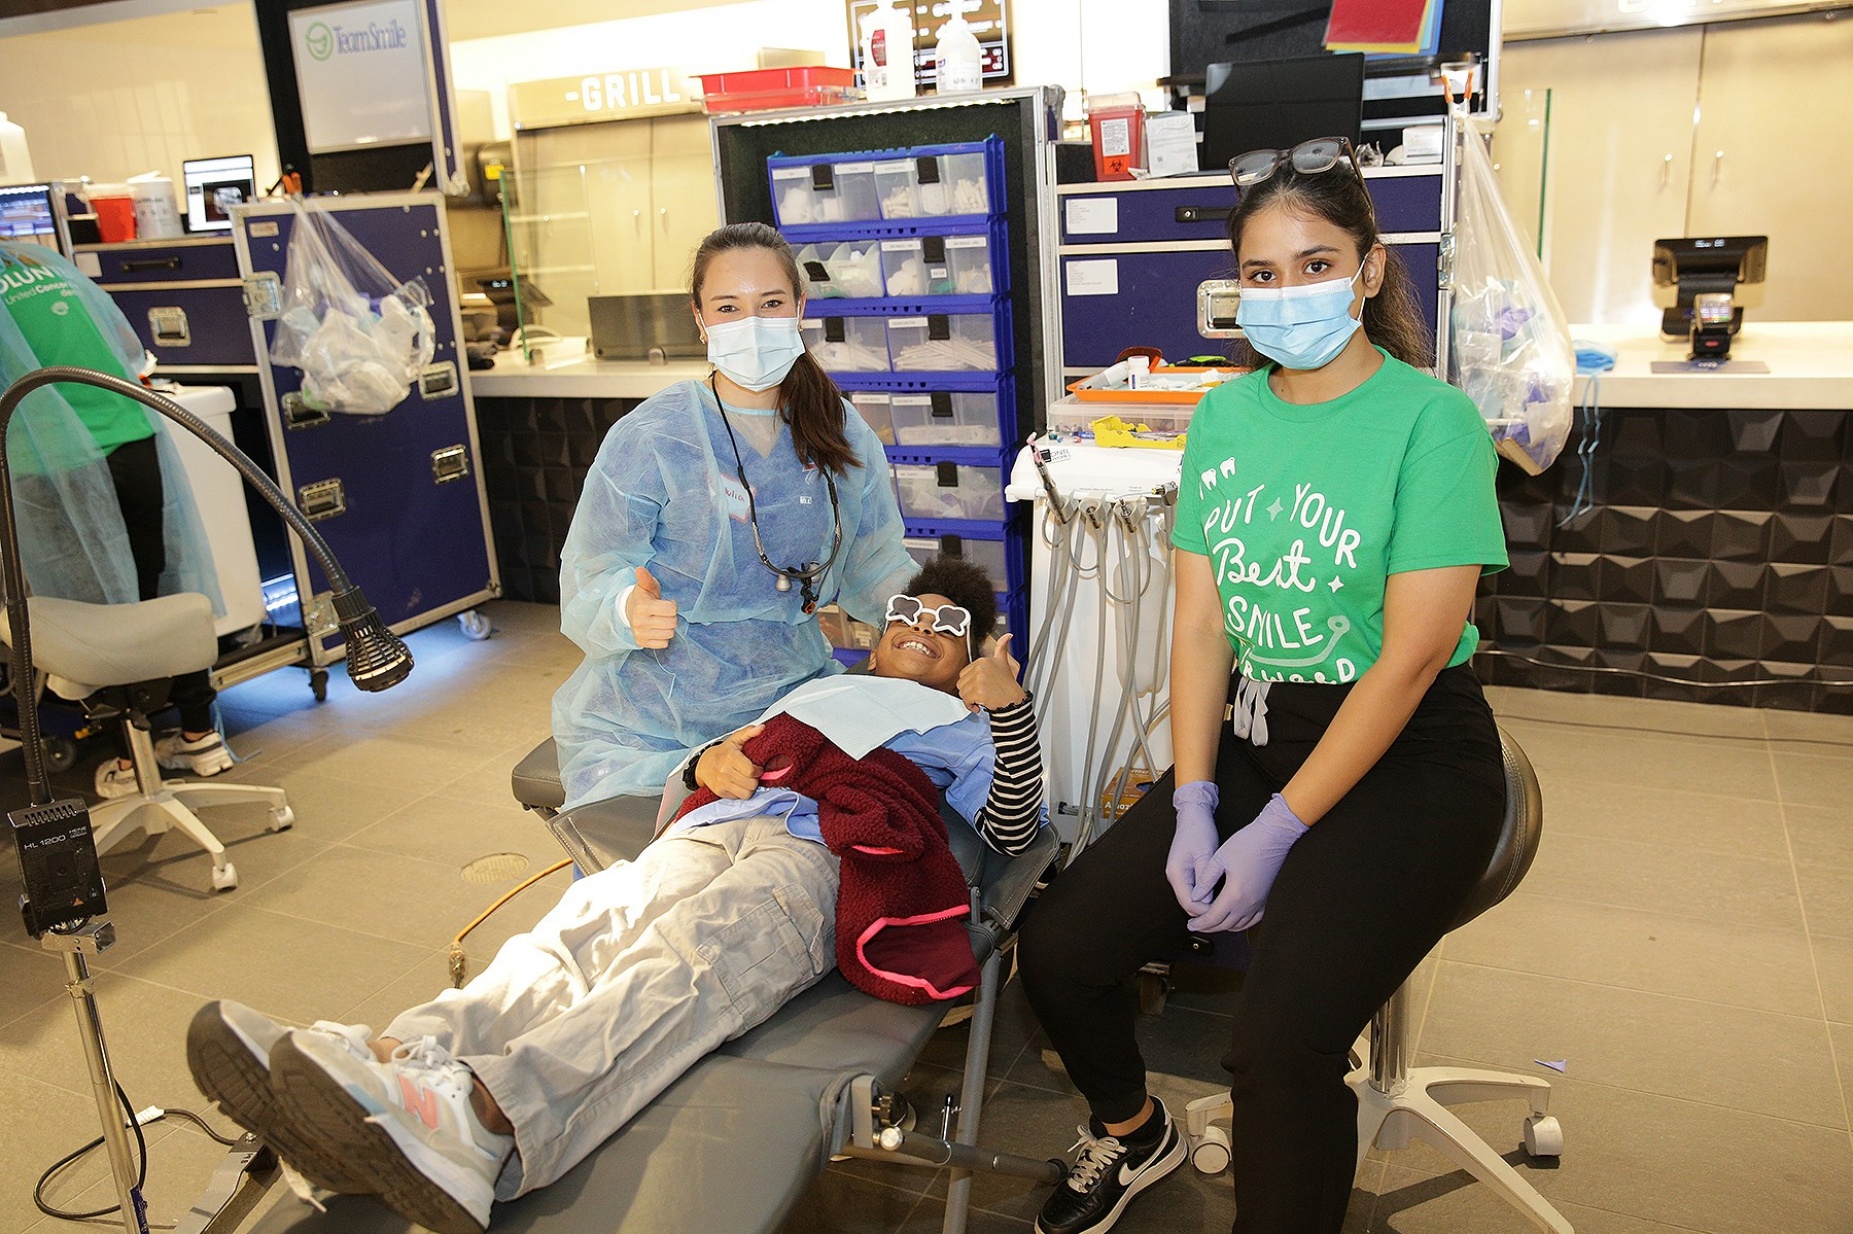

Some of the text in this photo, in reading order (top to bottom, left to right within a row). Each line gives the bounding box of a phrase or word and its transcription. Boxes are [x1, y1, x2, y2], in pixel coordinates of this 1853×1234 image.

[332, 19, 406, 54] TeamSmile
[1203, 482, 1361, 569] PUT YOUR
[1212, 537, 1316, 593] Best
[1226, 595, 1324, 649] SMILE
[24, 842, 38, 850] HL
[40, 834, 66, 847] 1200
[396, 1073, 440, 1130] N
